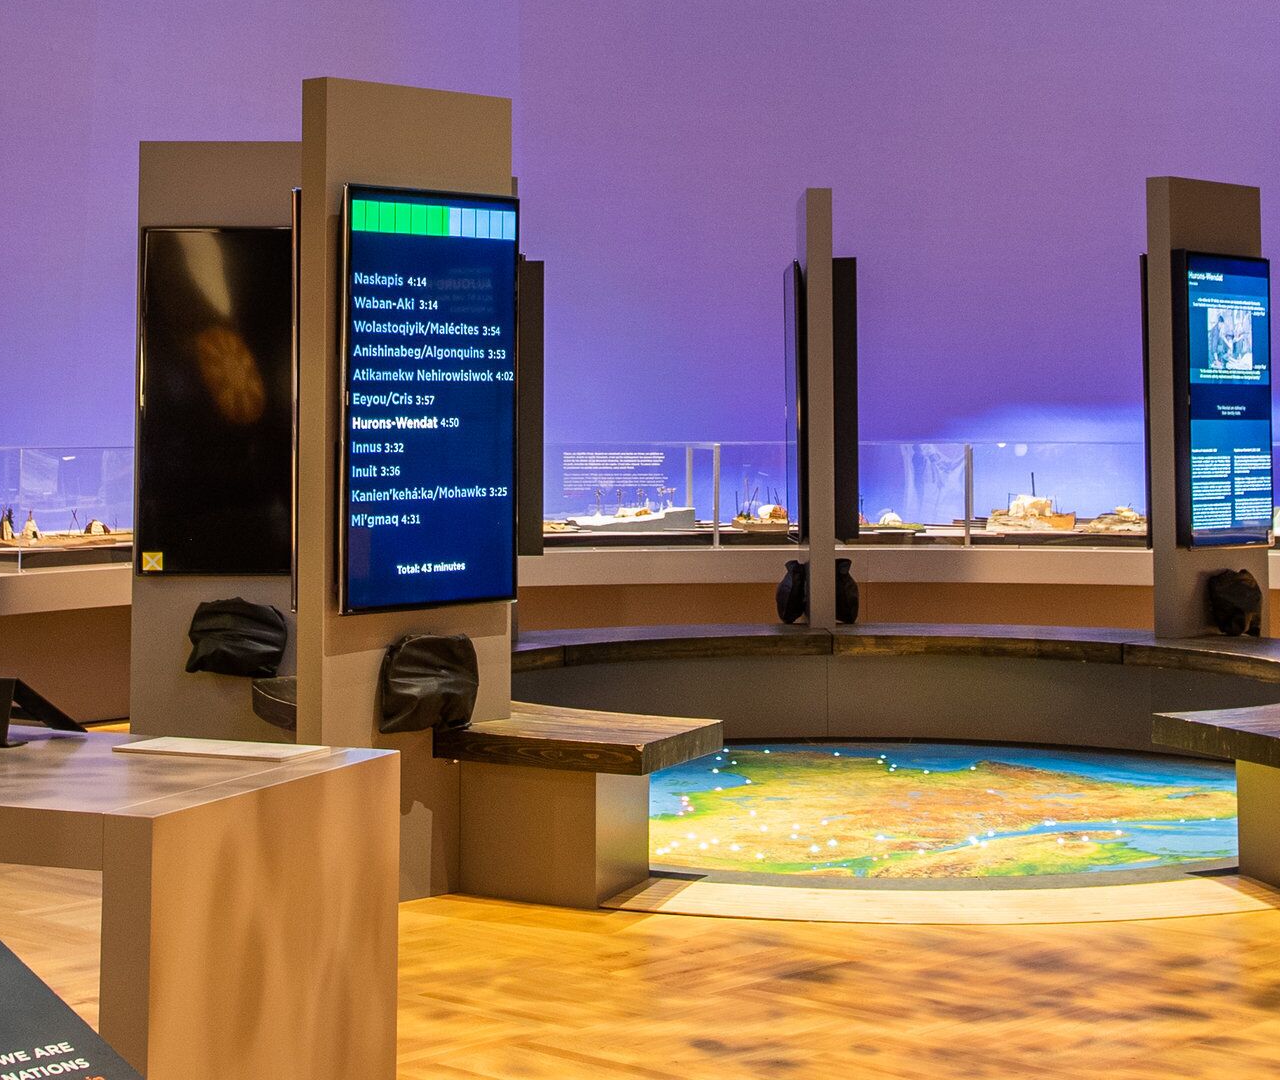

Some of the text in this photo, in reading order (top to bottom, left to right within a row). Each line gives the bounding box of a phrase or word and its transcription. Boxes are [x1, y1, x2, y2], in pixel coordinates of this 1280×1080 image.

[355, 273, 426, 287] Naskapis 4:14
[354, 297, 438, 310] Waban-Aki 3:14
[354, 321, 500, 336] Wolastoqiyik/Malécites 3:54
[354, 345, 505, 360] Anishinabeg/Algonquins 3:53
[353, 369, 513, 381] Atikamekw Nehirowisiwok 4:02
[353, 392, 434, 407] Eeyou/Cris 3:57
[353, 416, 459, 429] Hurons-Wendat 4:50
[353, 442, 404, 453] Innus 3:32
[353, 465, 400, 477] Inuit 3:36
[490, 487, 507, 496] 3:25
[401, 515, 420, 524] 4:31
[397, 562, 465, 574] Total: 43 minutes
[34, 1042, 75, 1059] ARE
